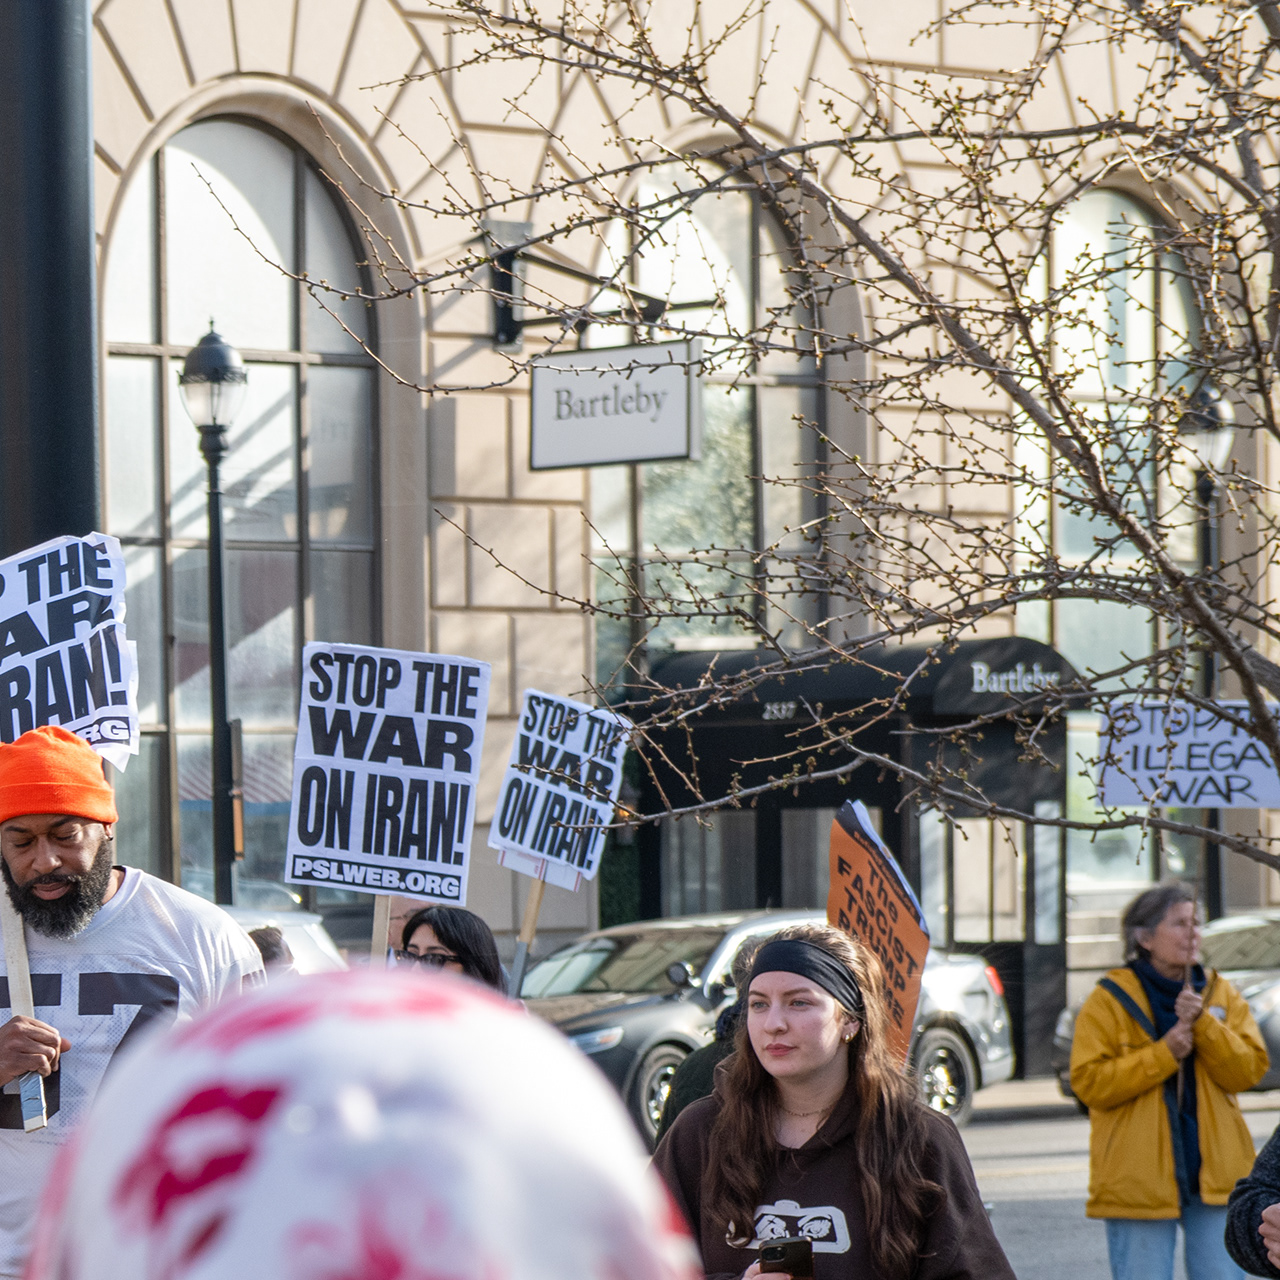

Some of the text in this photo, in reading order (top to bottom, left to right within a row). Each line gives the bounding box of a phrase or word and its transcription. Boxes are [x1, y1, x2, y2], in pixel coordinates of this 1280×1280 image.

[554, 380, 668, 423] Bartleby
[18, 541, 114, 606] THE
[308, 652, 481, 719] STOP THE
[971, 661, 1060, 698] Bartleby
[307, 705, 475, 774] WAR
[523, 695, 624, 764] STOP THE
[1132, 739, 1272, 772] ILLEGA
[519, 733, 614, 804] WAR
[1147, 774, 1258, 806] WAR
[297, 765, 471, 867] ON IRAN!
[498, 777, 604, 871] ON IRAN!
[293, 857, 461, 898] PSLWEB.ORG
[867, 858, 899, 924] The
[837, 855, 919, 978] FASCIST
[844, 886, 906, 994] TRUMP
